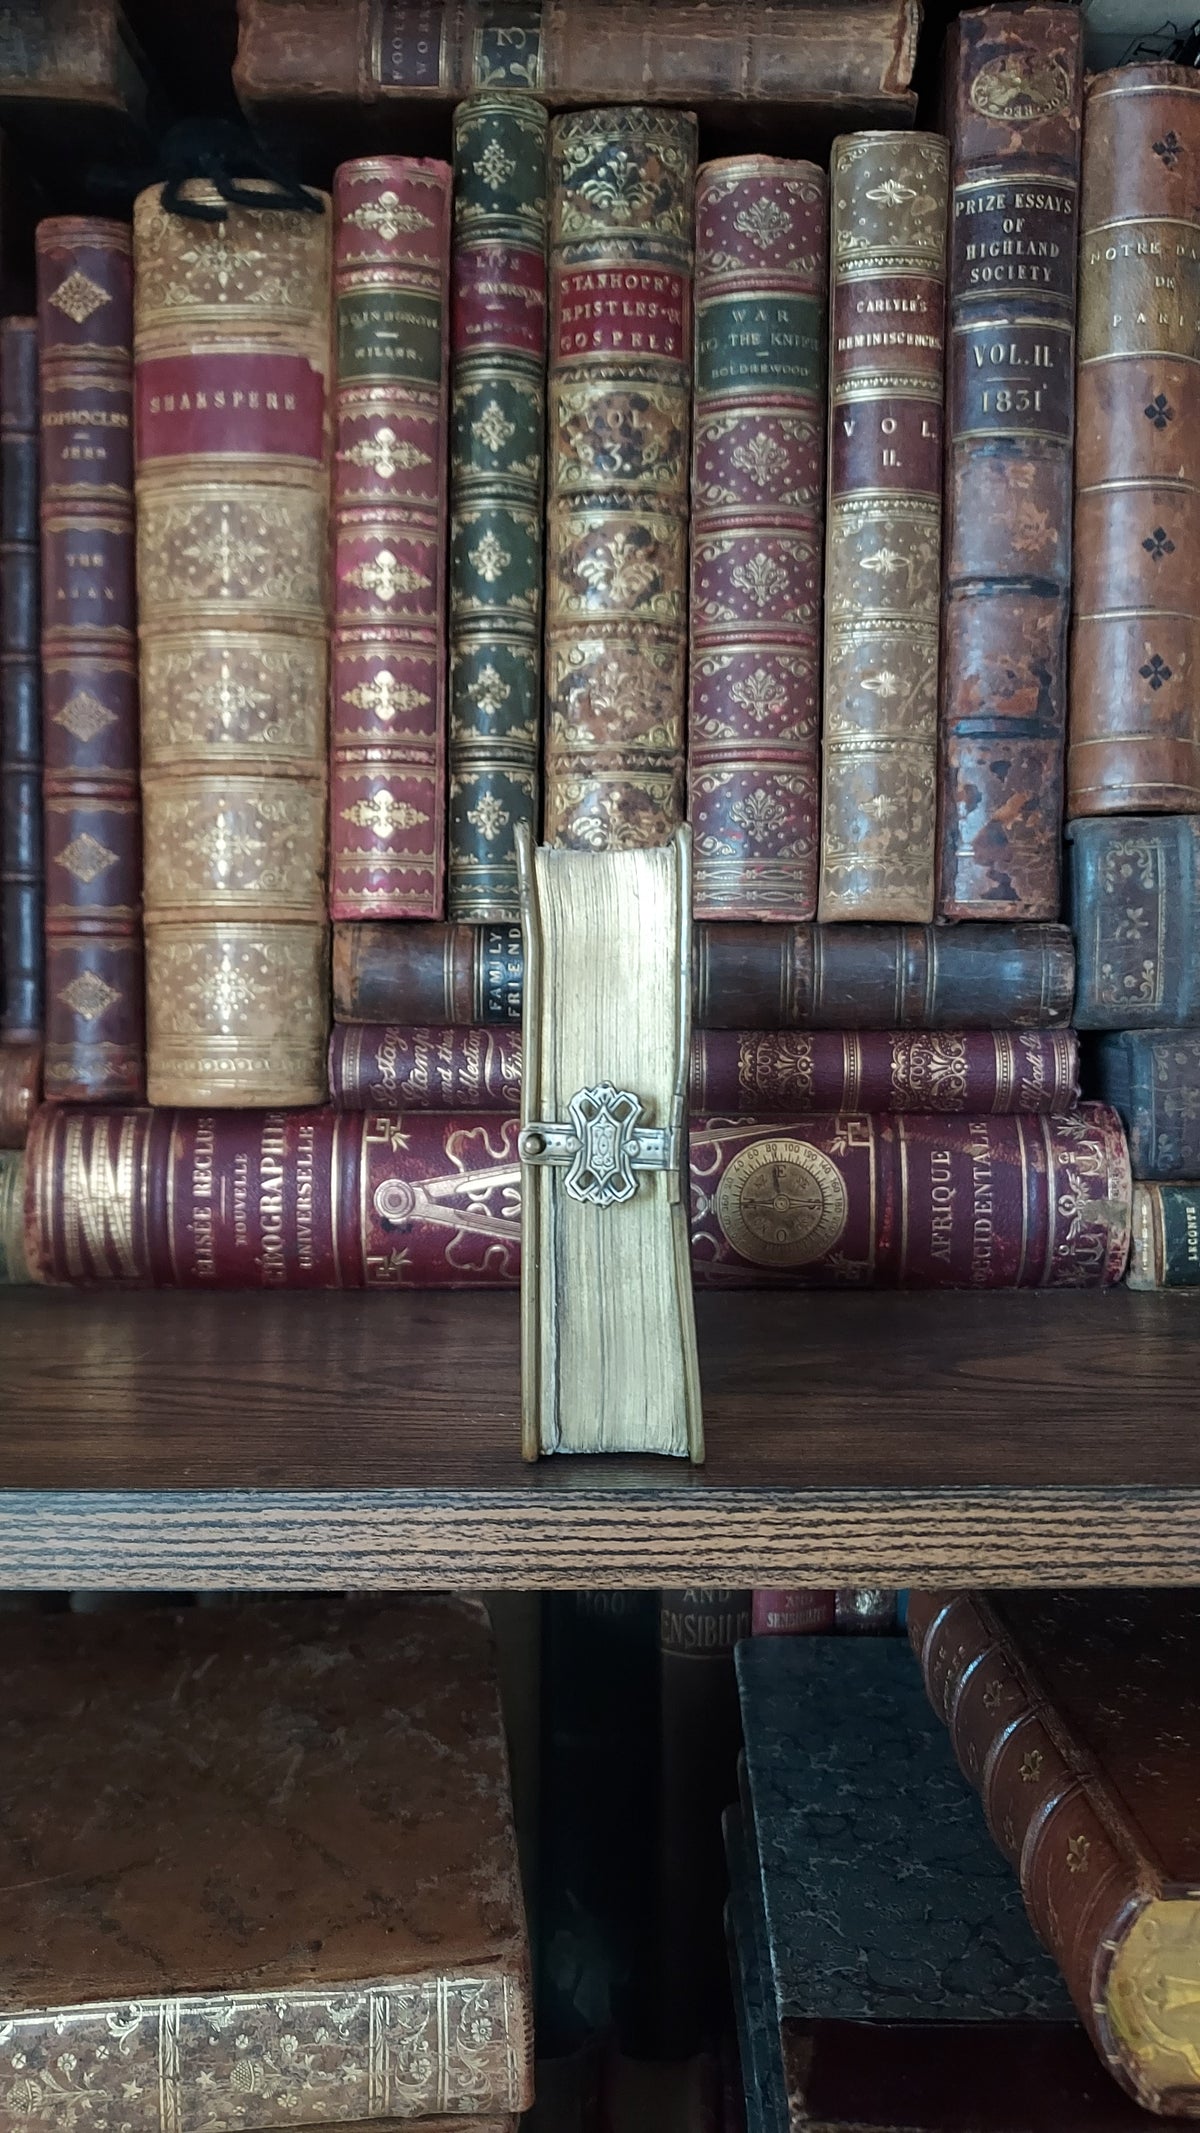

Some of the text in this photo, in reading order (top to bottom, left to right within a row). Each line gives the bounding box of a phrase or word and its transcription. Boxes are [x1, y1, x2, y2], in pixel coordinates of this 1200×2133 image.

[955, 192, 1073, 218] PRIZE ESSAYS
[1002, 217, 1026, 234] OF
[965, 240, 1061, 261] HIGHLAND
[1090, 242, 1162, 265] NOTRE
[560, 273, 681, 298] STANHOPE'S
[970, 264, 1052, 284] SOCIETY
[1155, 276, 1175, 289] DE
[561, 300, 657, 324] EPISTLES
[856, 293, 928, 314] CARLYLE'S
[731, 308, 790, 323] WAR
[560, 330, 675, 352] GOSPELS
[728, 331, 761, 348] THE
[711, 362, 810, 379] BOLDREWOOD
[981, 388, 1042, 413] 1831
[488, 931, 503, 1011] FAMILY
[507, 927, 521, 1018] FRIEND
[370, 1027, 409, 1106] Postage
[401, 1027, 435, 1106] Stamps
[457, 1030, 481, 1105] Collection
[747, 1148, 759, 1160] 60
[765, 1143, 778, 1153] 80
[784, 1143, 800, 1153] 100
[803, 1148, 818, 1161] 120
[733, 1160, 745, 1173] 40
[186, 1117, 215, 1278] ÉLISÉE RECLUS
[234, 1153, 248, 1246] NOUVELLE
[255, 1112, 286, 1283] GÉOGRAPHIE
[296, 1126, 313, 1270] UNIVERSELLE
[834, 1197, 842, 1213] 180
[931, 1150, 957, 1264] AFRIQUE
[969, 1122, 993, 1283] OCCIDENTALE
[1186, 1206, 1198, 1262] LECONTE
